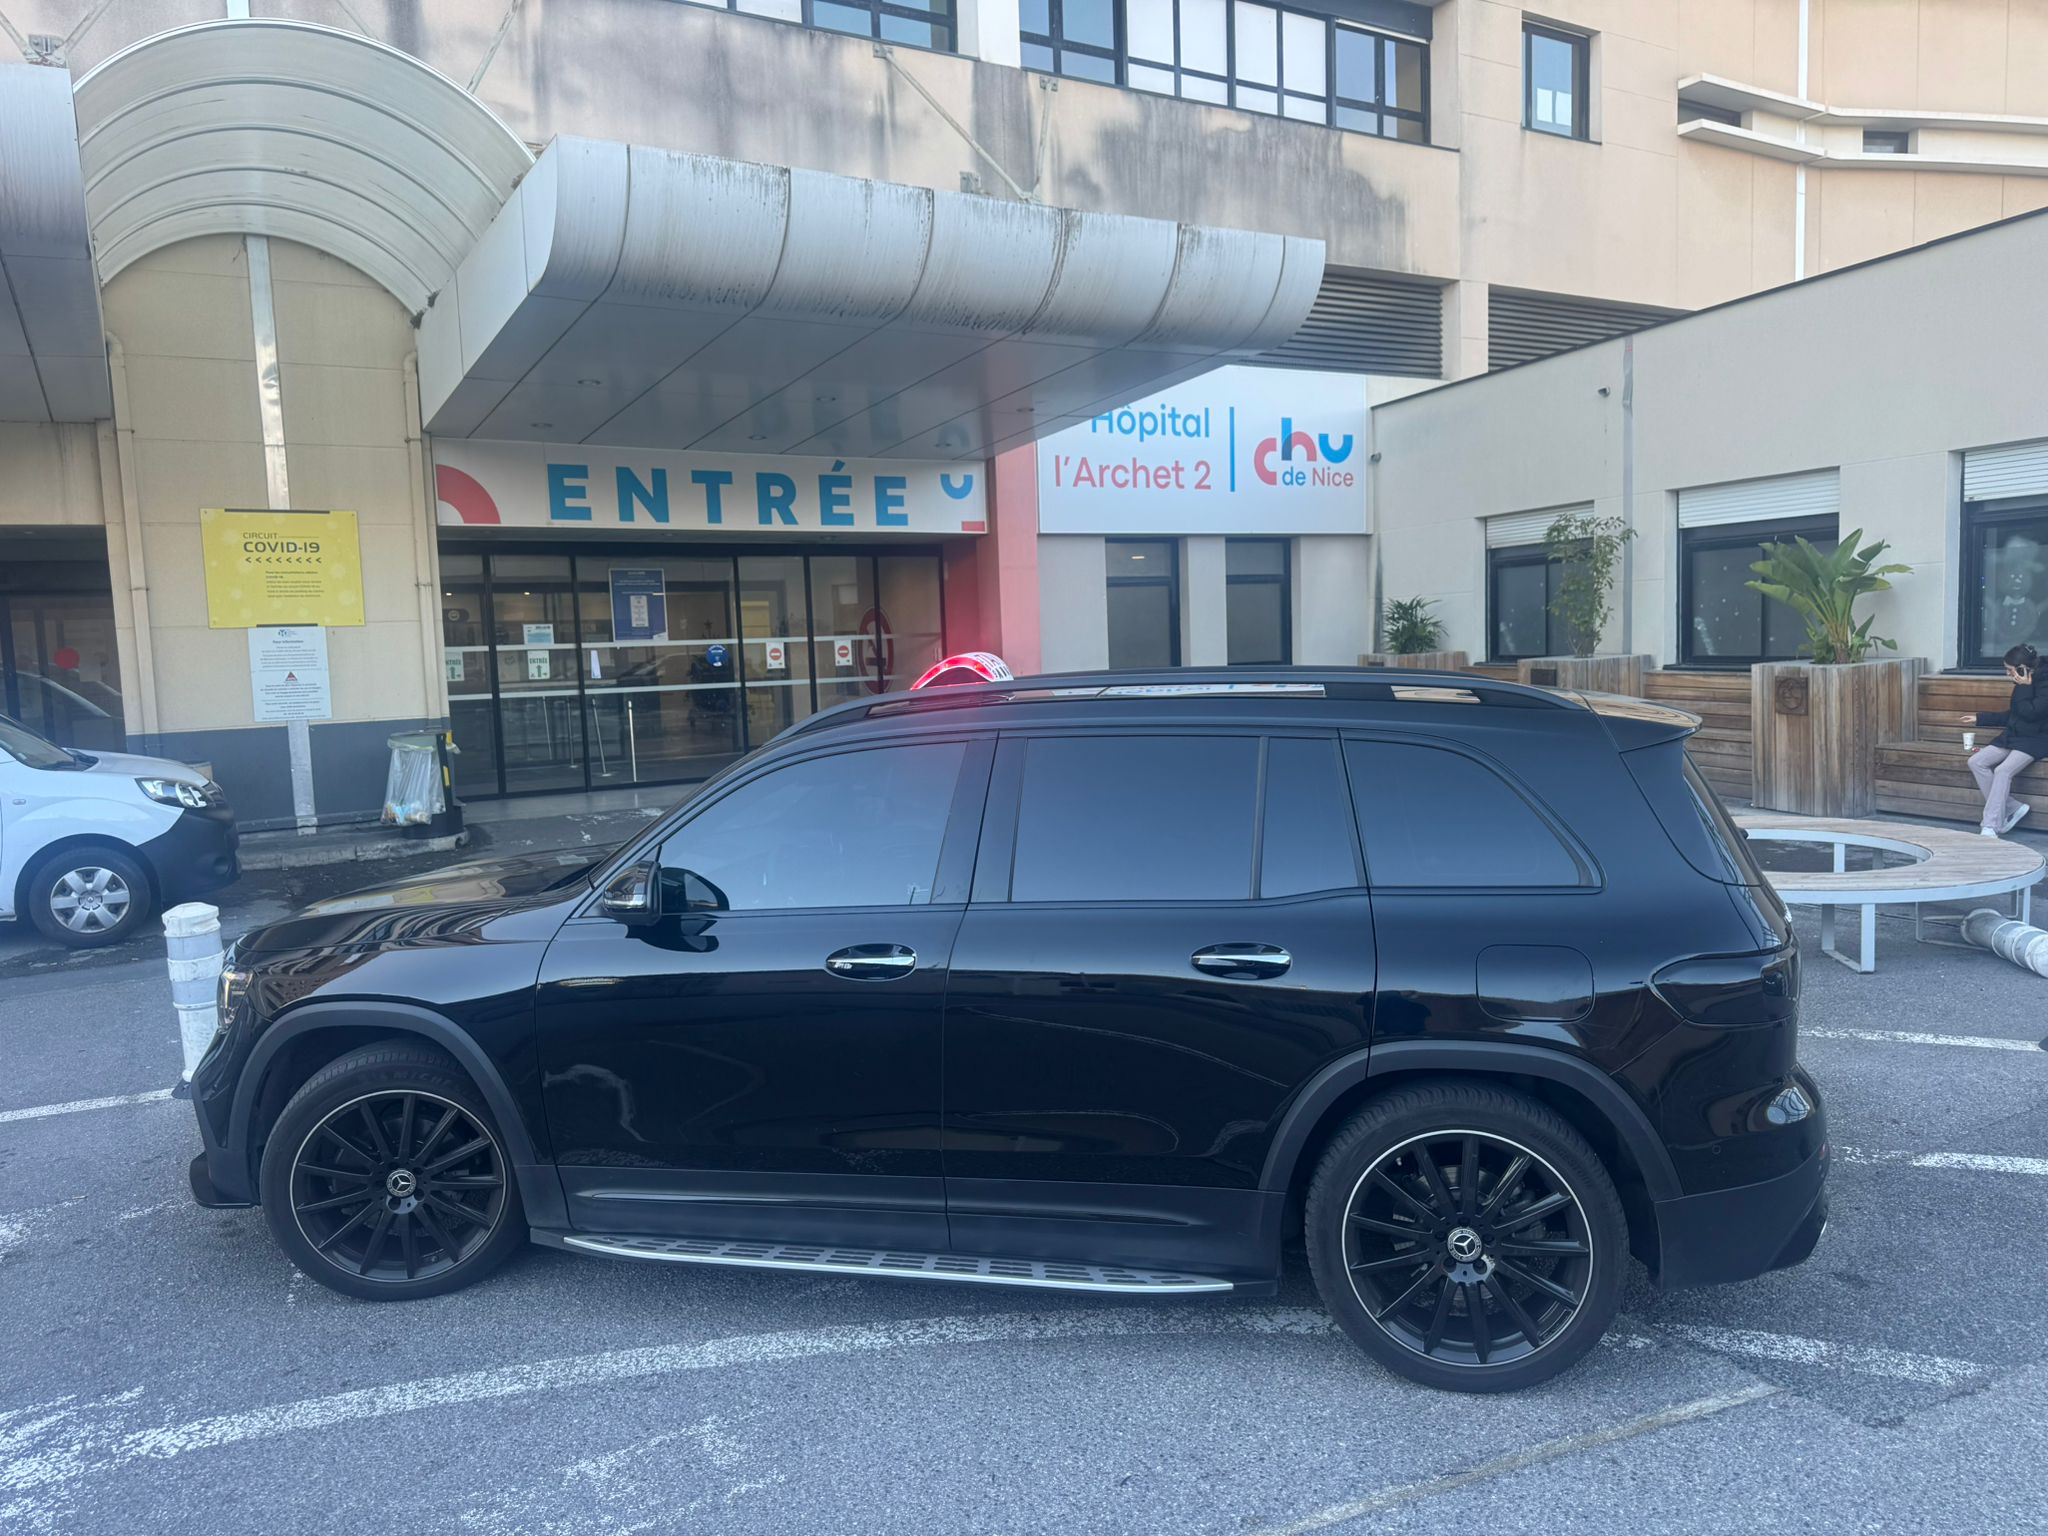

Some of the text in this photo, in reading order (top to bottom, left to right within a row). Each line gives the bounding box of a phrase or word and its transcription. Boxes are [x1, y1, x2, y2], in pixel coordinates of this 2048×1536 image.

[1253, 417, 1354, 487] chu
[1054, 454, 1212, 491] l'Archet 2
[1281, 465, 1355, 488] de Nice
[546, 459, 909, 528] ENTRÉE
[242, 532, 278, 540] CIRCUIT
[243, 541, 321, 554] COVID-19
